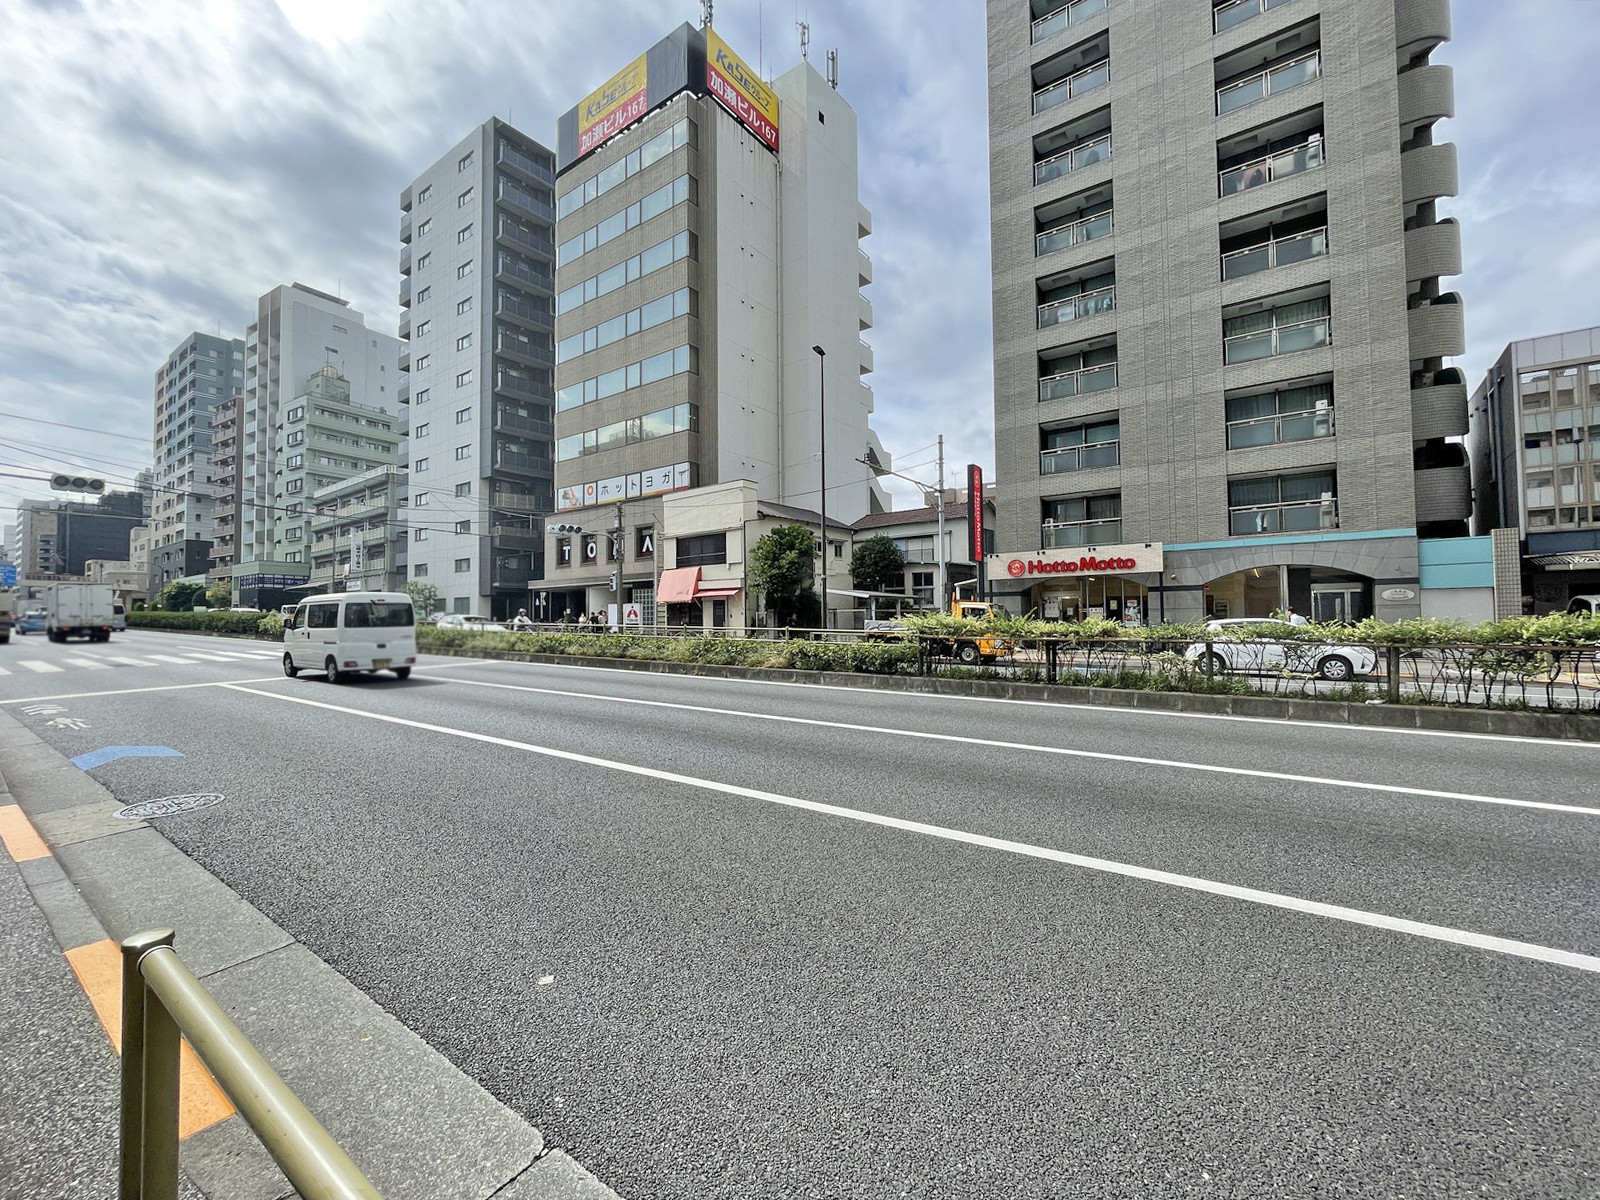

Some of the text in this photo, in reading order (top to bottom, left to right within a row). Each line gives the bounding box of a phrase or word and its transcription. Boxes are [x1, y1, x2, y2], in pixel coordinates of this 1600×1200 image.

[601, 470, 672, 496] ホットヨガ
[1028, 560, 1078, 574] Hotto
[1079, 556, 1136, 571] Motto
